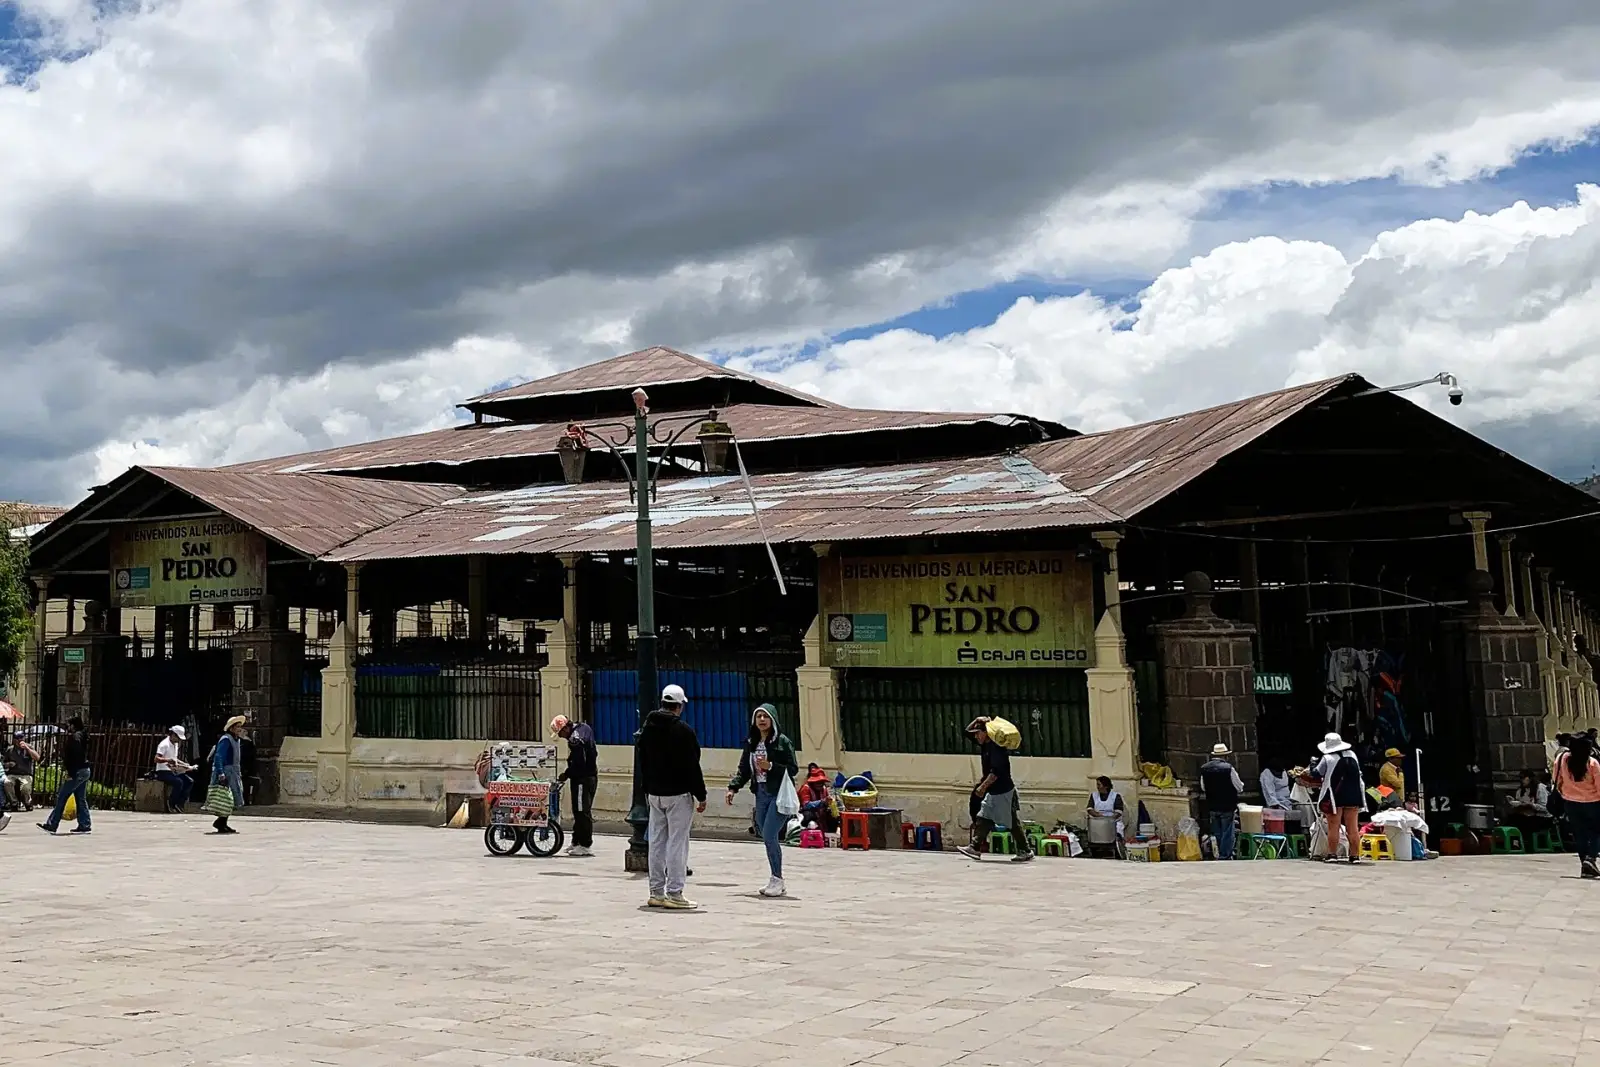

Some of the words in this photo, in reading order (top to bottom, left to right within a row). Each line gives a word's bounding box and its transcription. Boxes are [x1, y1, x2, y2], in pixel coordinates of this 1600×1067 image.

[189, 525, 200, 537] AL
[181, 541, 212, 557] SAN
[161, 557, 237, 581] PEDRO
[843, 562, 951, 579] BIENVENIDOS
[955, 561, 975, 576] AL
[979, 559, 1063, 577] MERCADO
[203, 589, 228, 599] CAJA
[230, 587, 263, 598] CUSCO
[945, 582, 997, 603] SAN
[909, 603, 1040, 635] PEDRO
[981, 649, 1026, 661] CAJA
[1030, 649, 1088, 661] CUSCO
[1252, 675, 1291, 691] ALIDA
[1430, 796, 1451, 812] 12
